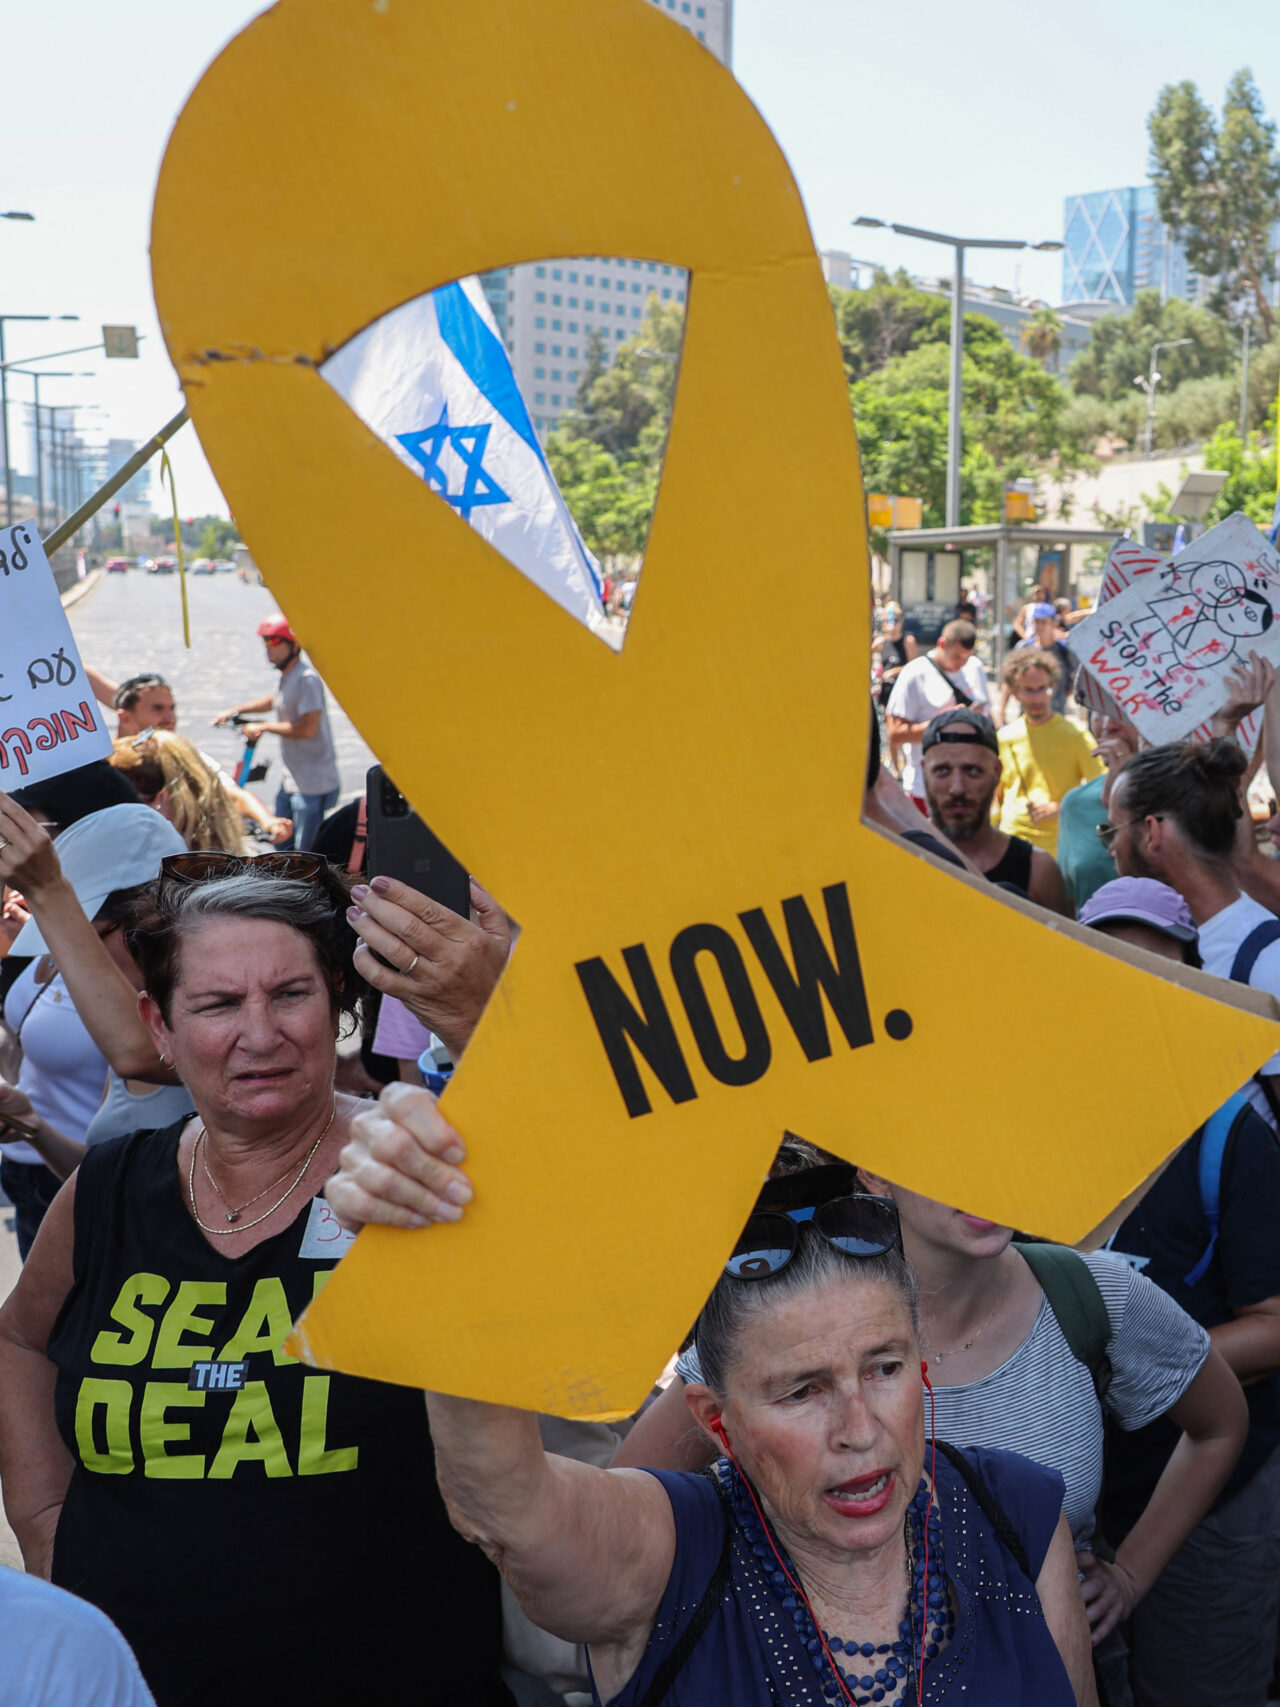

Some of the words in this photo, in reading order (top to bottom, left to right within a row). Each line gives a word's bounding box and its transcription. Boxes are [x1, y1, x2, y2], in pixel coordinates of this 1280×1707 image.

[27, 647, 77, 689] עם
[1100, 620, 1148, 668] STOP
[574, 881, 914, 1119] NOW.
[195, 1363, 245, 1389] THE
[75, 1375, 359, 1479] DEAL
